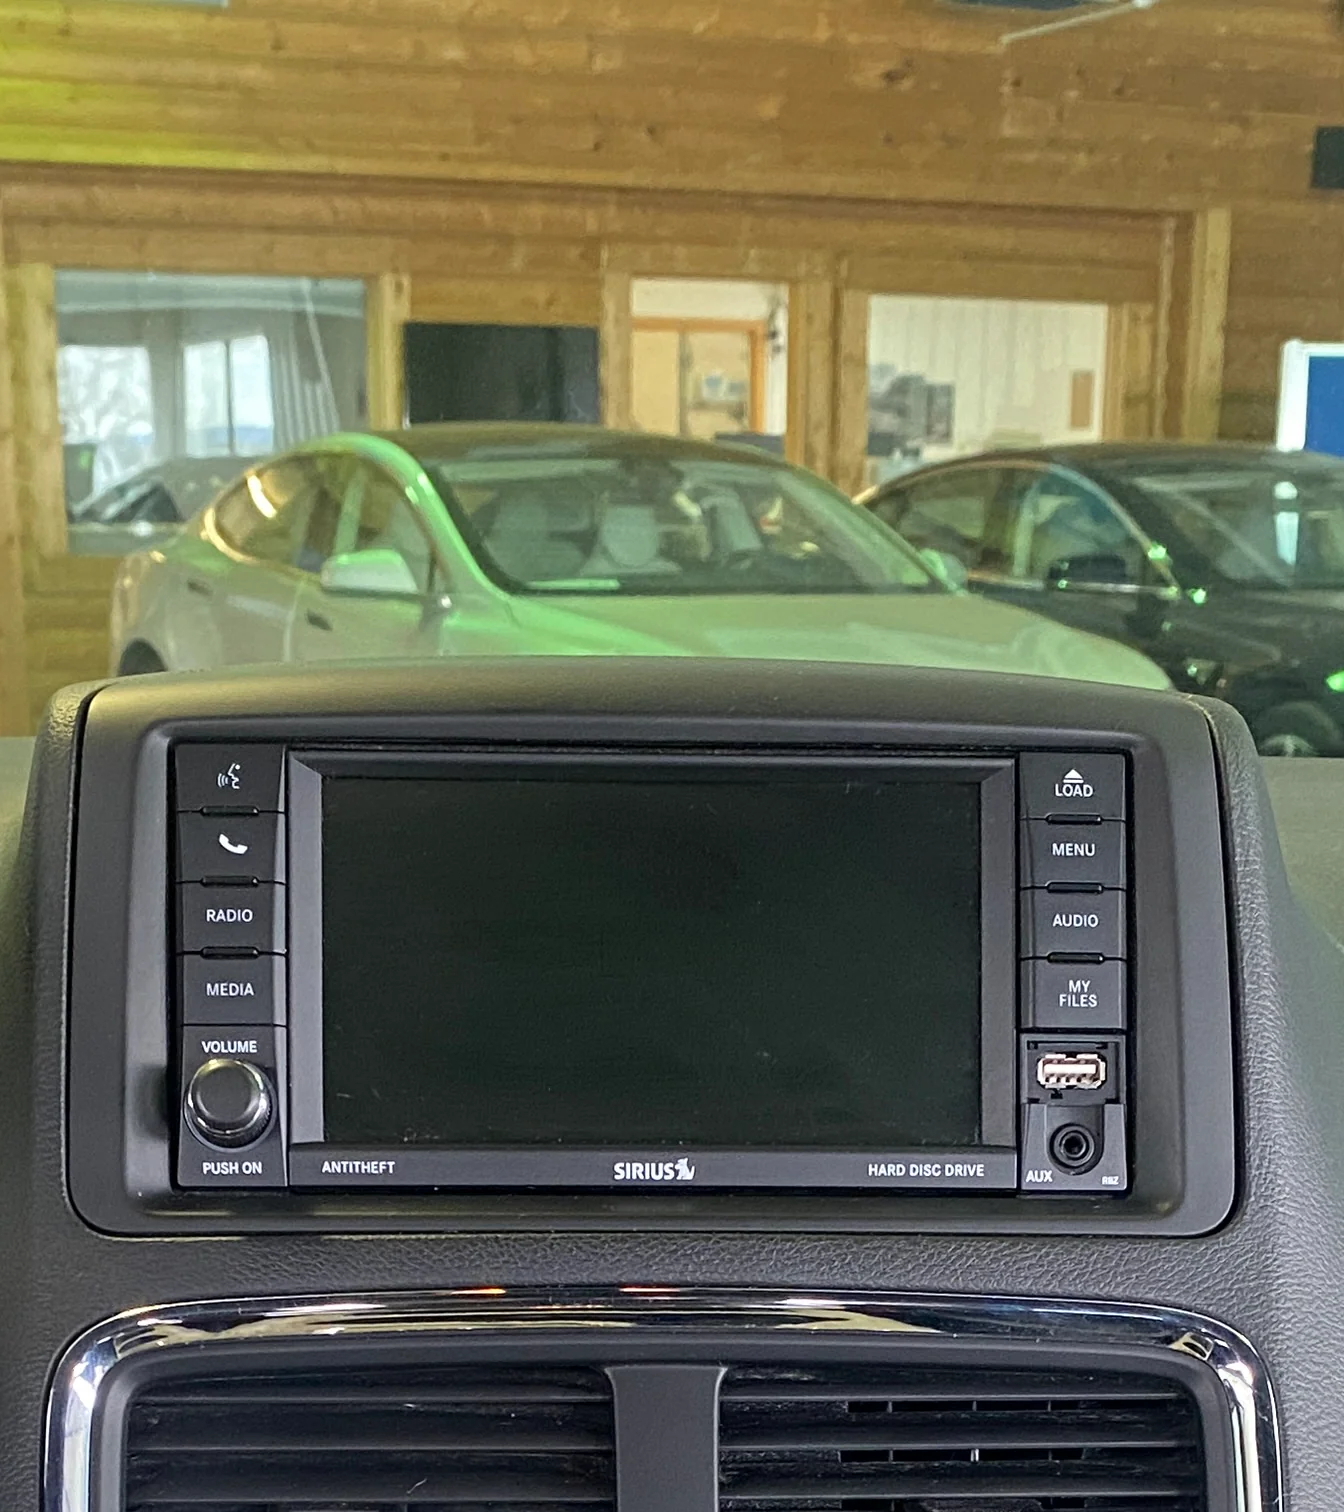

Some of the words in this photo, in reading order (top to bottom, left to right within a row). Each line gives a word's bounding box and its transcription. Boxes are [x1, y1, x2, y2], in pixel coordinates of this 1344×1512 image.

[1055, 783, 1094, 798] LOAD
[1052, 842, 1096, 857] MENU
[206, 908, 253, 923] RADIO
[1052, 913, 1099, 928] AUDIO
[205, 982, 254, 996] MEDIA
[1068, 980, 1091, 994] MY
[1059, 994, 1098, 1008] FILES
[201, 1040, 258, 1054] VOLUME
[202, 1161, 240, 1175] PUSH
[242, 1161, 263, 1175] ON
[321, 1160, 396, 1174] ANTITHEFT
[613, 1162, 675, 1181] SIRIUS
[868, 1163, 906, 1177] HARD
[908, 1163, 942, 1177] DISC
[944, 1163, 985, 1177] DRIVE
[1025, 1169, 1053, 1183] AUX
